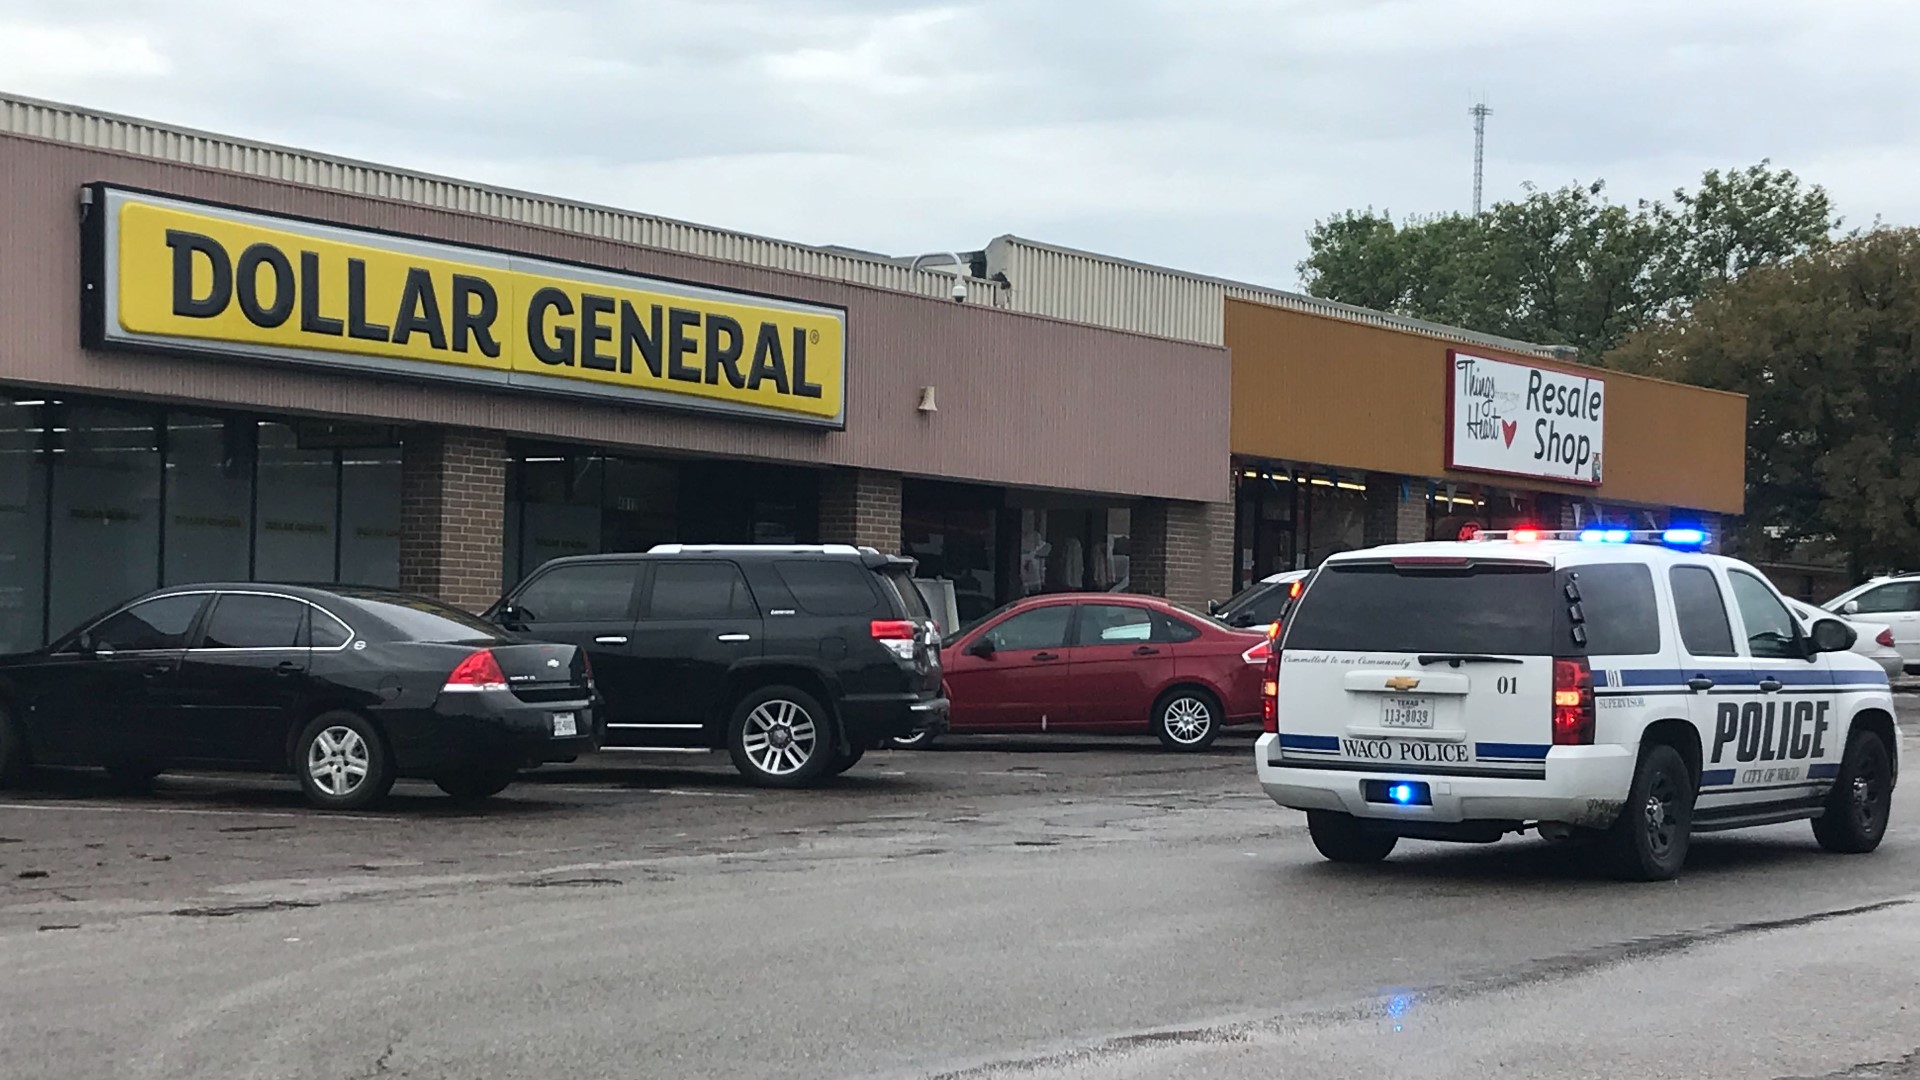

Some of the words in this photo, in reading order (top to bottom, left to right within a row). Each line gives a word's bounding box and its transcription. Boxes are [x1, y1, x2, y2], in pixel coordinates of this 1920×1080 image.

[165, 229, 502, 357] DOLLAR
[1456, 359, 1495, 417] Things
[1526, 369, 1602, 422] Resale
[1467, 402, 1502, 440] Heart
[1534, 418, 1591, 476] Shop
[1330, 656, 1338, 665] to
[1497, 676, 1518, 695] 01
[1608, 669, 1620, 688] 01
[1598, 696, 1646, 709] SUPERVISOR
[1710, 700, 1830, 764] POLICE
[1342, 738, 1393, 760] WACO
[1399, 742, 1470, 763] POLICE
[1742, 769, 1764, 784] CITY
[1764, 767, 1777, 783] OF
